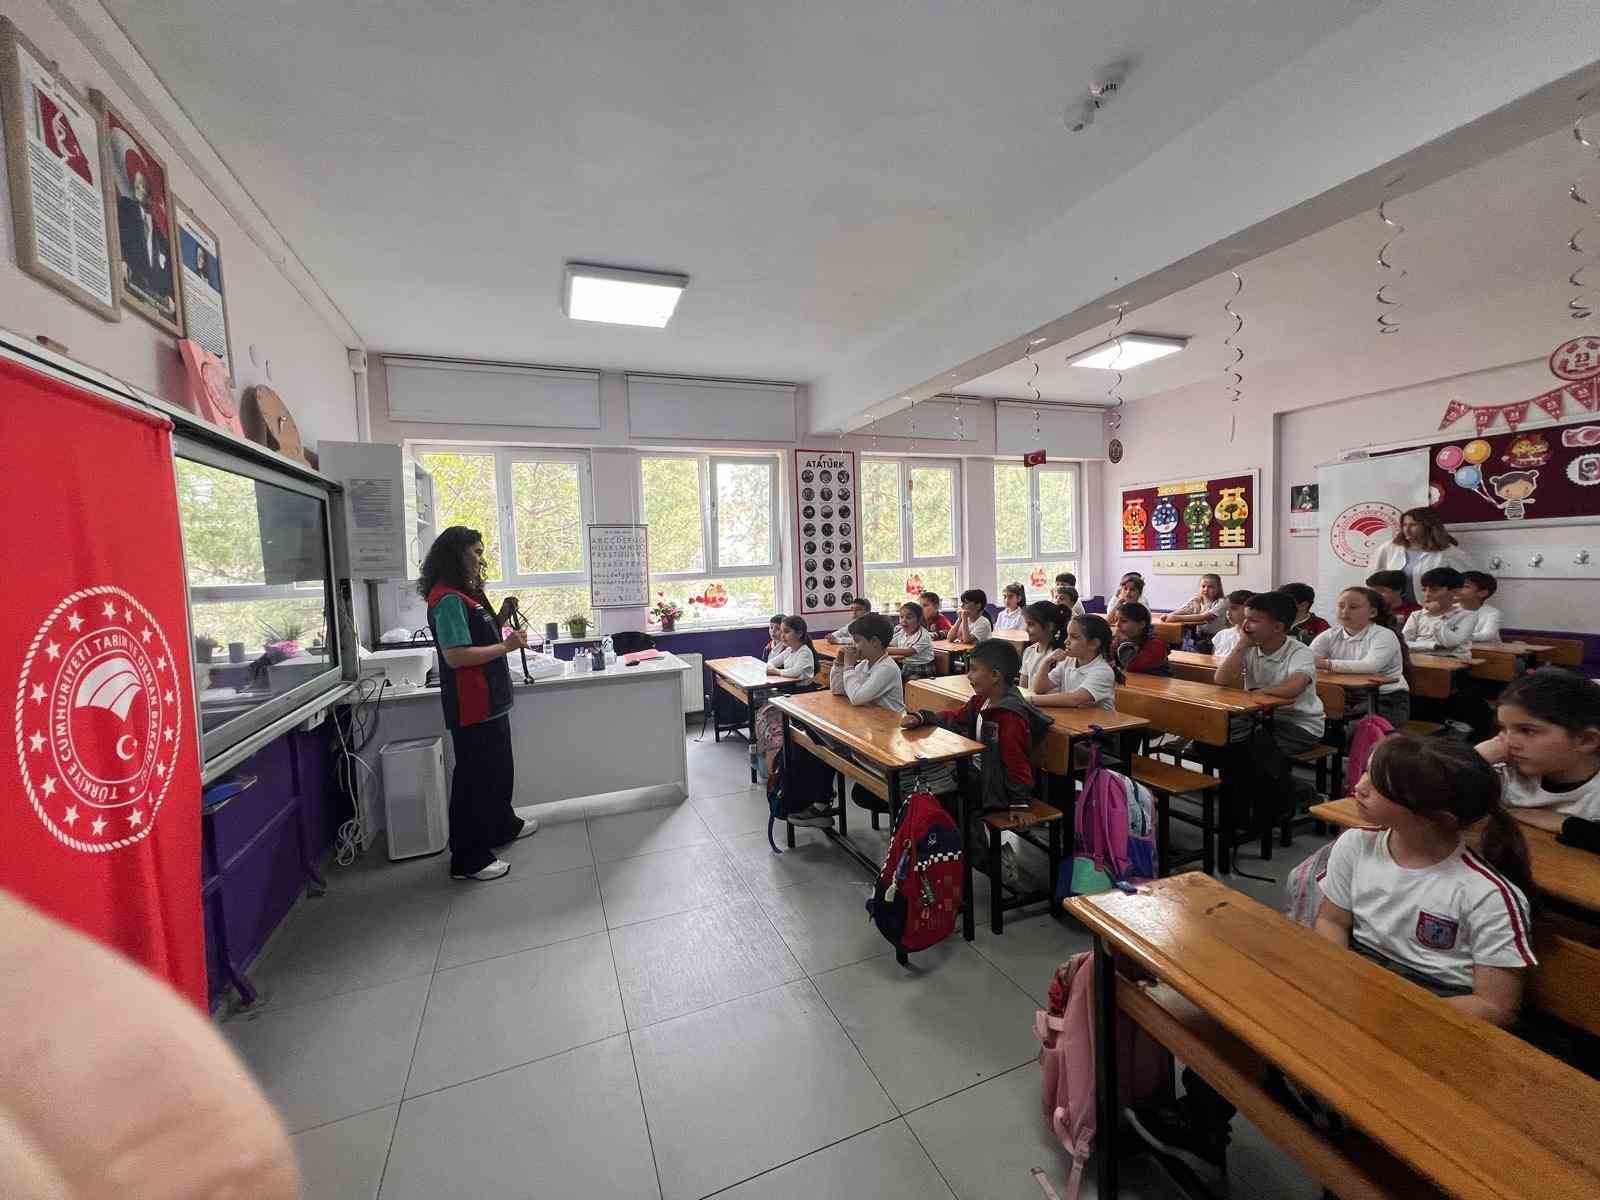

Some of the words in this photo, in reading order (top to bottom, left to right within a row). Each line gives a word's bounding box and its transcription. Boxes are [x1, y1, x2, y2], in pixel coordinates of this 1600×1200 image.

[806, 458, 844, 468] ATATÜRK
[55, 643, 92, 762] CUMHURİYETİ
[141, 710, 159, 786] BAKANI
[67, 762, 118, 802] TÜRKİYE
